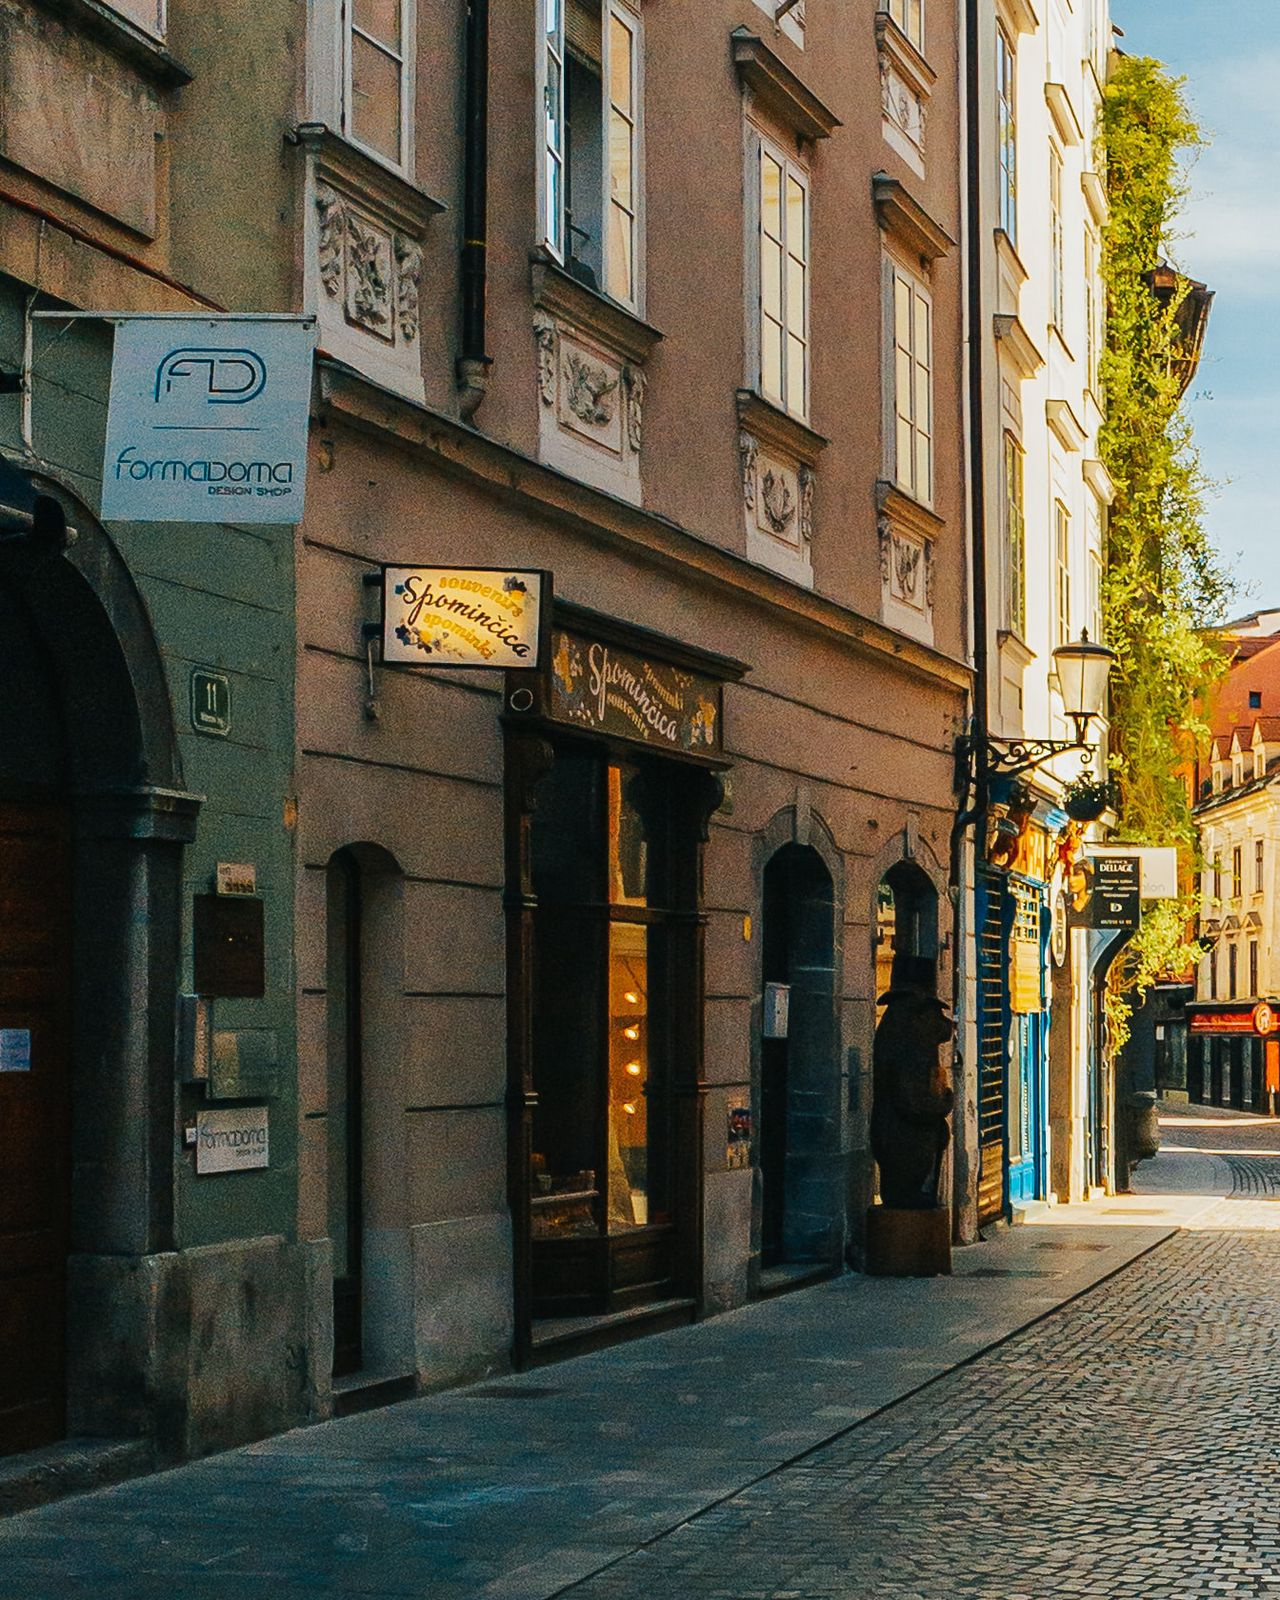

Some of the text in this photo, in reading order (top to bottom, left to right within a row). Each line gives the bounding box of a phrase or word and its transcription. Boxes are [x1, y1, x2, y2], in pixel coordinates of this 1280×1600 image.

[208, 486, 292, 497] DESIGN SHOP
[402, 575, 531, 658] Spominčica
[438, 576, 524, 618] souvenirs
[423, 612, 497, 661] spominki
[206, 682, 217, 712] 11
[588, 642, 678, 742] Spominčica
[1099, 863, 1134, 874] DELLAGE
